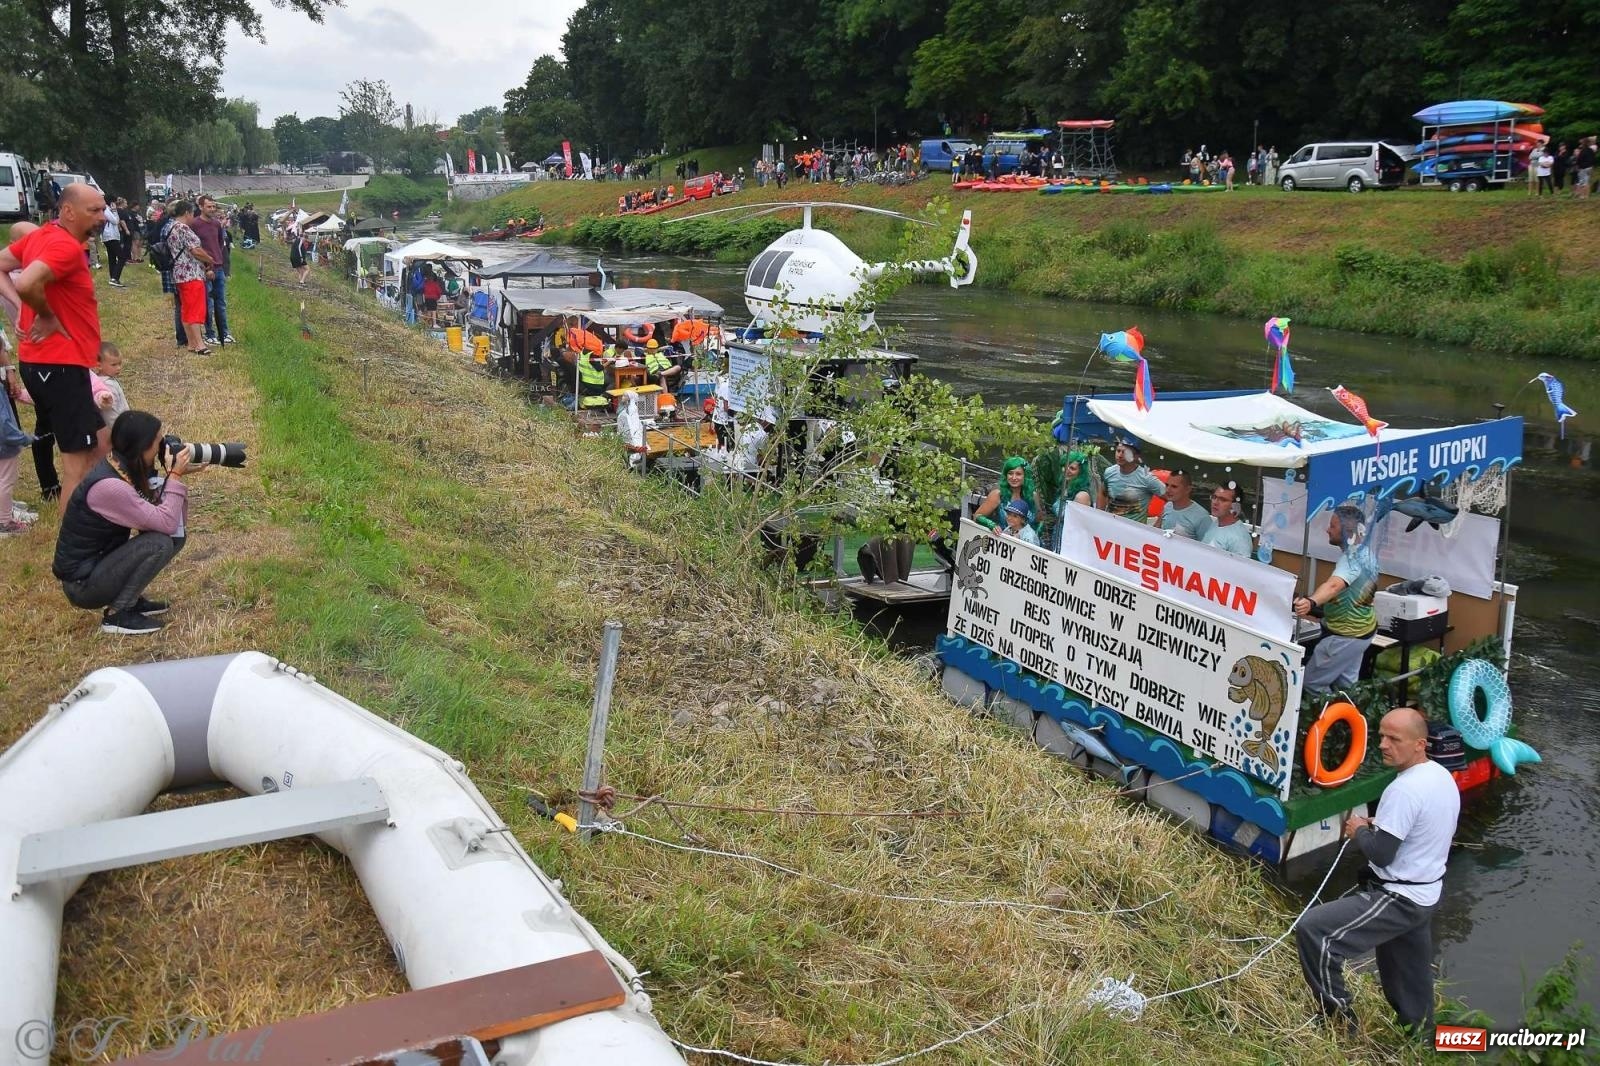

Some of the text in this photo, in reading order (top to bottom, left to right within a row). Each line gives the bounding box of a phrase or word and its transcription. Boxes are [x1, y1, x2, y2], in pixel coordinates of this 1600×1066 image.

[1351, 435, 1487, 486] WESOŁE UTOPKI
[976, 556, 1222, 673] BO GRZEGORZOWICE W DZIEWICZY
[987, 537, 1226, 652] RYBY SIĘ W ODRZE CHOWAJĄ
[1093, 536, 1258, 617] VIESSMANN
[954, 613, 967, 634] ŻE
[970, 623, 995, 648] DZIŚ
[998, 636, 1014, 658] NA
[1019, 648, 1059, 680] ODRZE
[1064, 667, 1129, 712] WSZYSCY
[963, 597, 1000, 626] NAWET
[1010, 617, 1055, 653] UTOPEK
[1067, 645, 1076, 662] O
[1086, 652, 1117, 681] TYM
[1129, 672, 1186, 713] DOBRZE
[1024, 600, 1143, 671] REJS WYRUSZAJĄ
